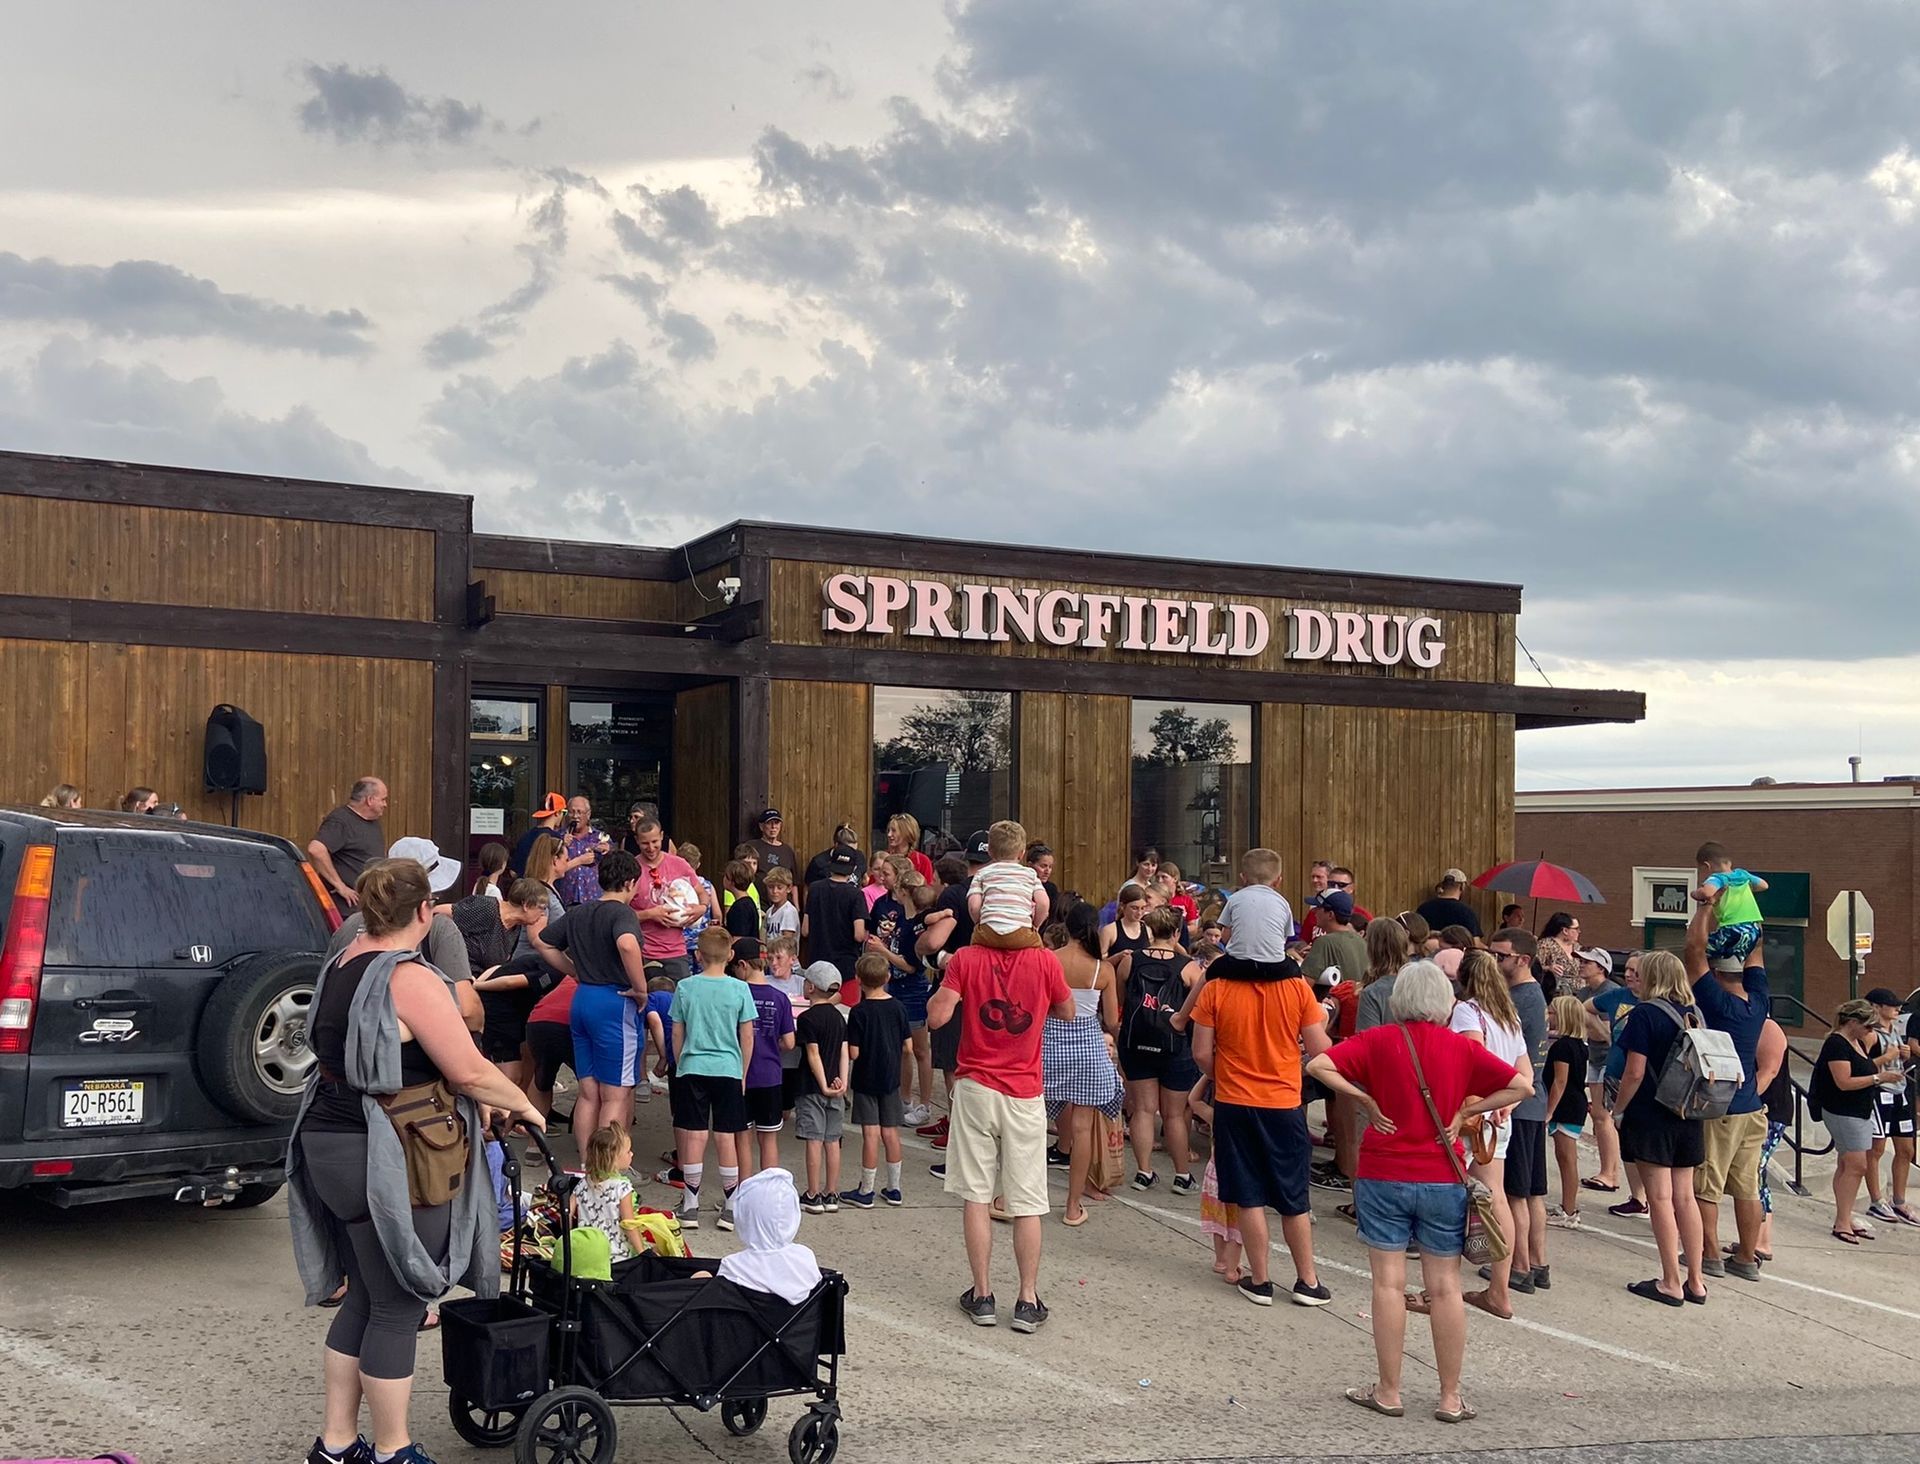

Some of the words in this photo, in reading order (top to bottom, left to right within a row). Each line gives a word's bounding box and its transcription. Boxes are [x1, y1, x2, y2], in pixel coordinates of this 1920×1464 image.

[823, 573, 1270, 657] SPRINGFIELD
[1287, 608, 1446, 669] DRUG
[84, 1082, 126, 1091] NEBRASKA
[70, 1091, 136, 1115] 20-R561
